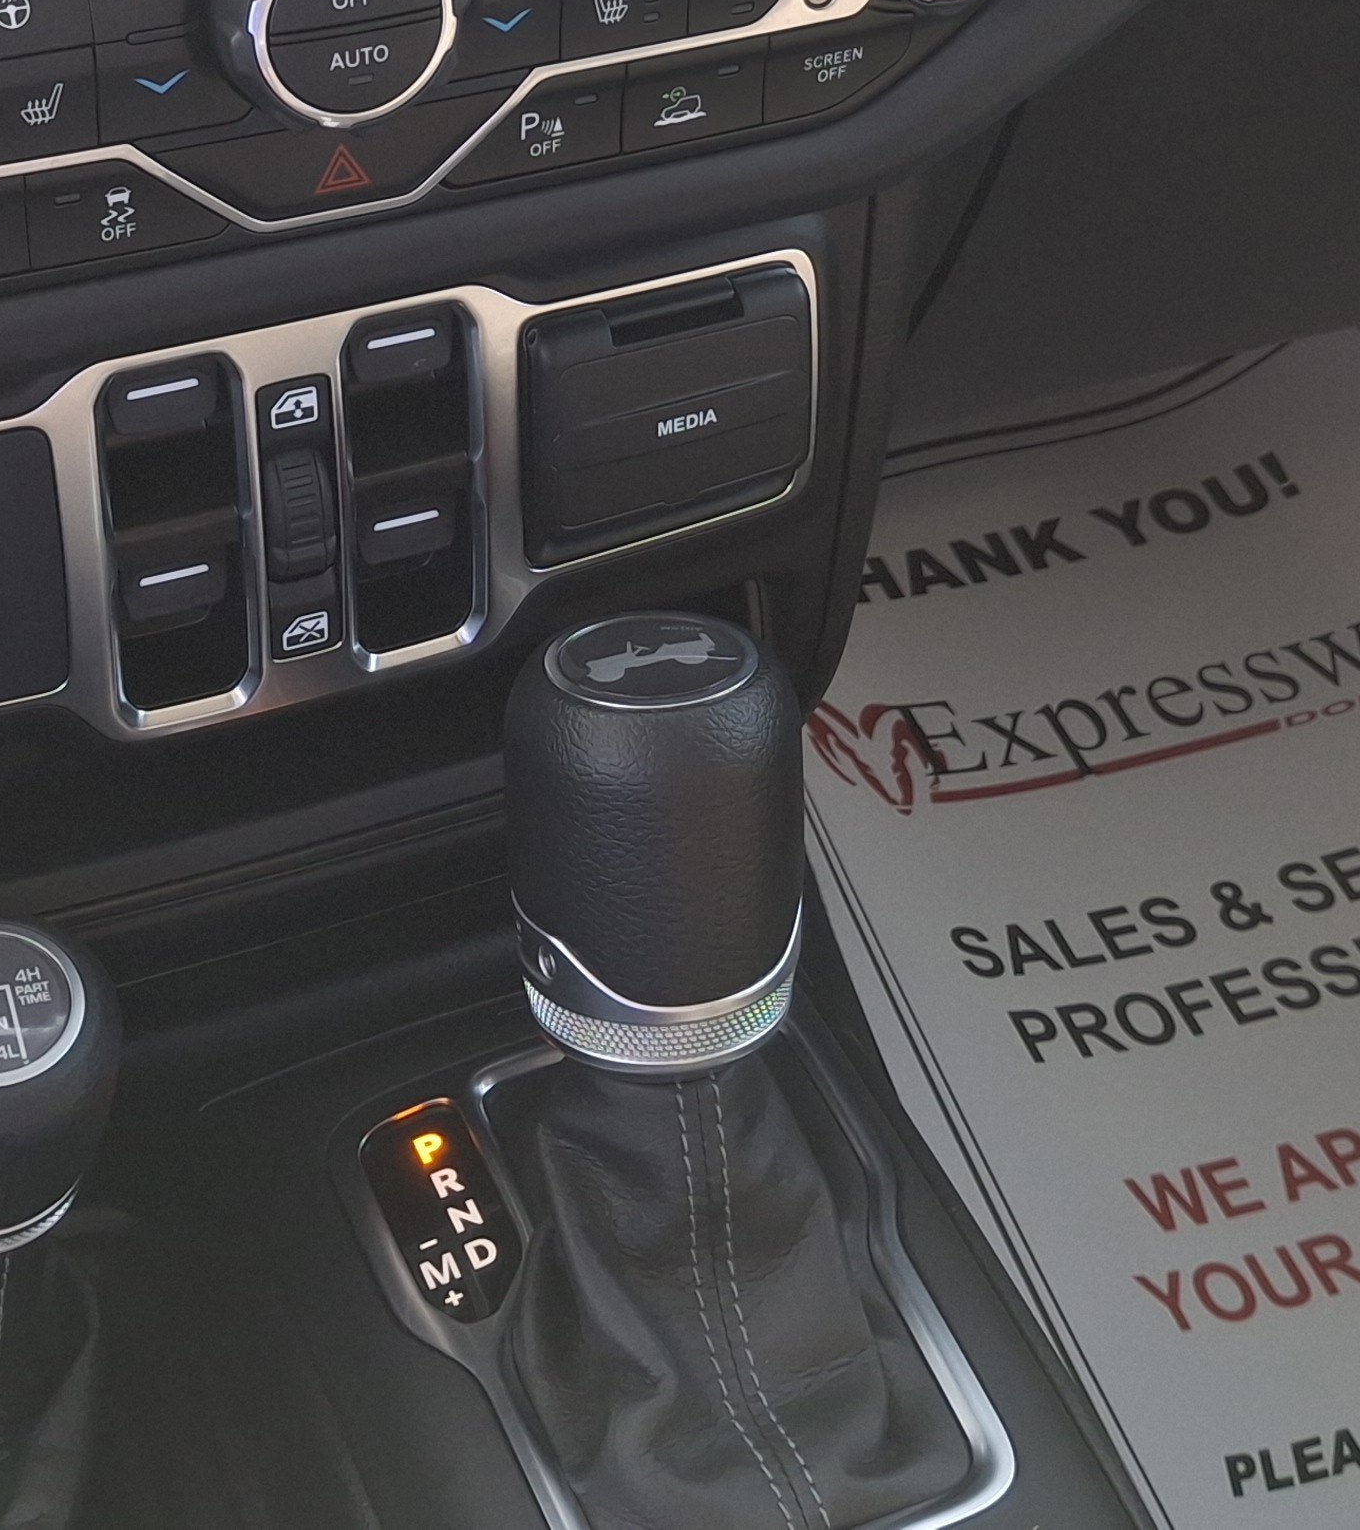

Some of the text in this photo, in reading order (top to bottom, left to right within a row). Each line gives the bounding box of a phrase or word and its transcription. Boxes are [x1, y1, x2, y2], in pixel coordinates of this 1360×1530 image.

[329, 43, 390, 72] AUTO
[803, 46, 864, 71] SCREEN
[817, 64, 846, 83] OFF
[520, 112, 541, 140] P
[529, 138, 562, 158] OFF
[100, 221, 136, 243] OFF
[656, 408, 719, 438] MEDIA
[856, 451, 1302, 603] HANK YOU!
[949, 895, 1198, 979] SALES
[1209, 880, 1275, 932] &
[14, 966, 42, 983] 4H
[14, 981, 50, 996] PART
[18, 991, 52, 1006] TIME
[411, 1132, 444, 1166] P
[429, 1167, 465, 1199] R
[1123, 1156, 1267, 1234] WE
[446, 1198, 484, 1234] N
[463, 1237, 498, 1271] D
[419, 1251, 462, 1291] M
